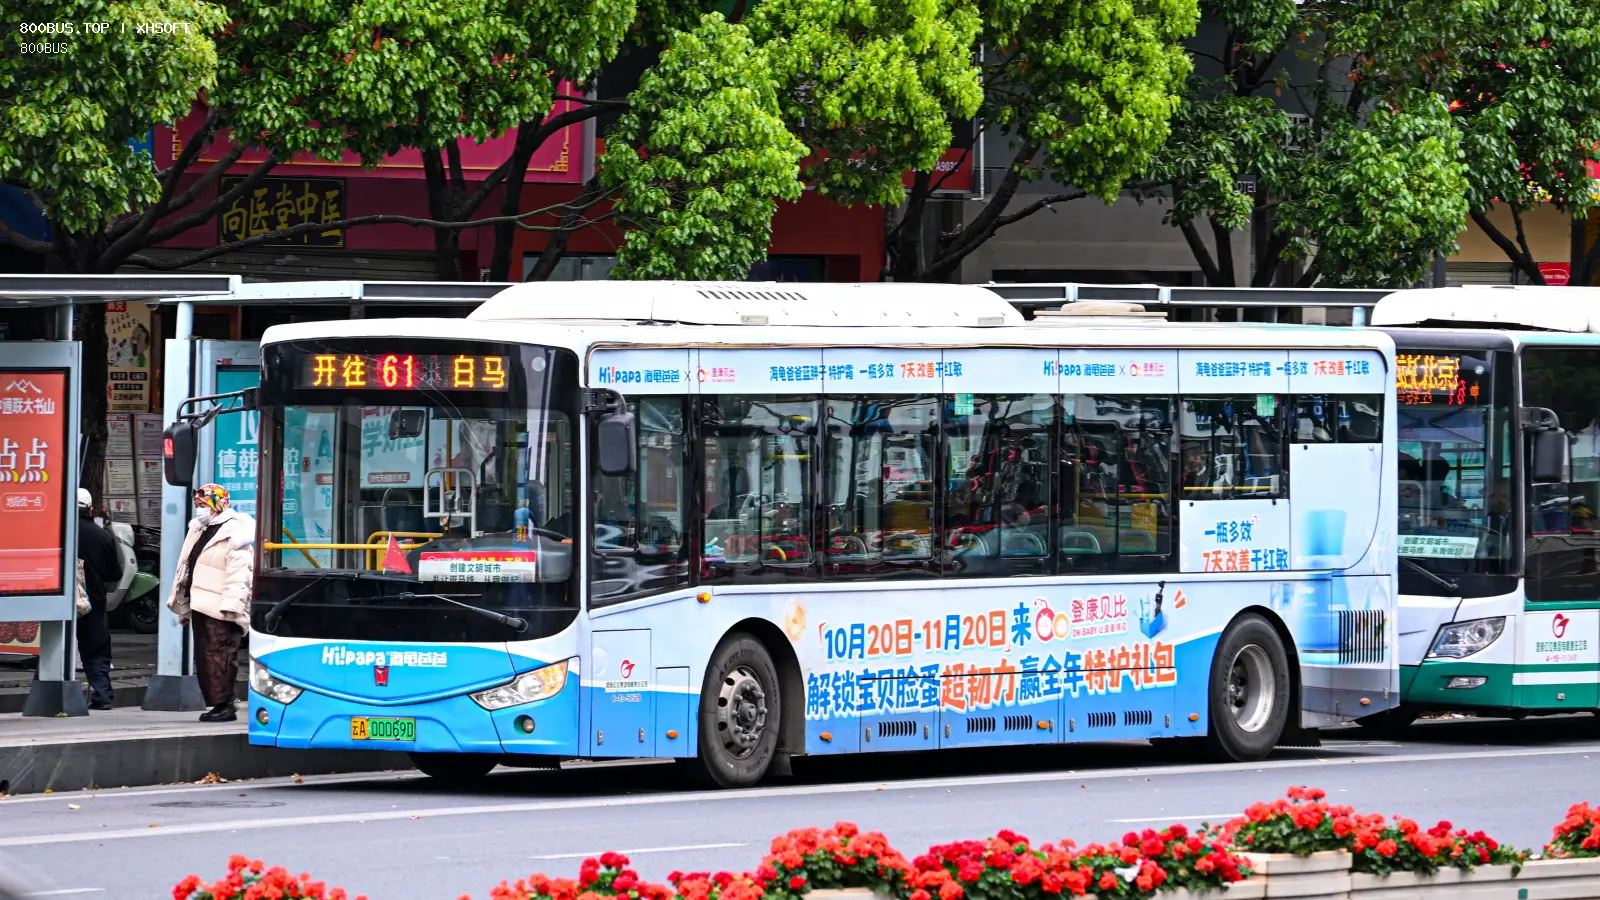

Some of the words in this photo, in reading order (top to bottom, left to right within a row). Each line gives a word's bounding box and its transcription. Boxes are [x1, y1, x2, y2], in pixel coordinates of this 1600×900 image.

[312, 354, 367, 388] 开往
[382, 354, 416, 388] 61
[452, 353, 507, 388] 白马
[599, 366, 642, 383] Hi!papa
[1205, 520, 1252, 544] 一瓶多效
[450, 563, 501, 573] 创建文明城市
[1202, 547, 1289, 572] 7天改善干红敏
[1071, 594, 1128, 623] 登康贝比
[322, 646, 385, 666] Hi!papa
